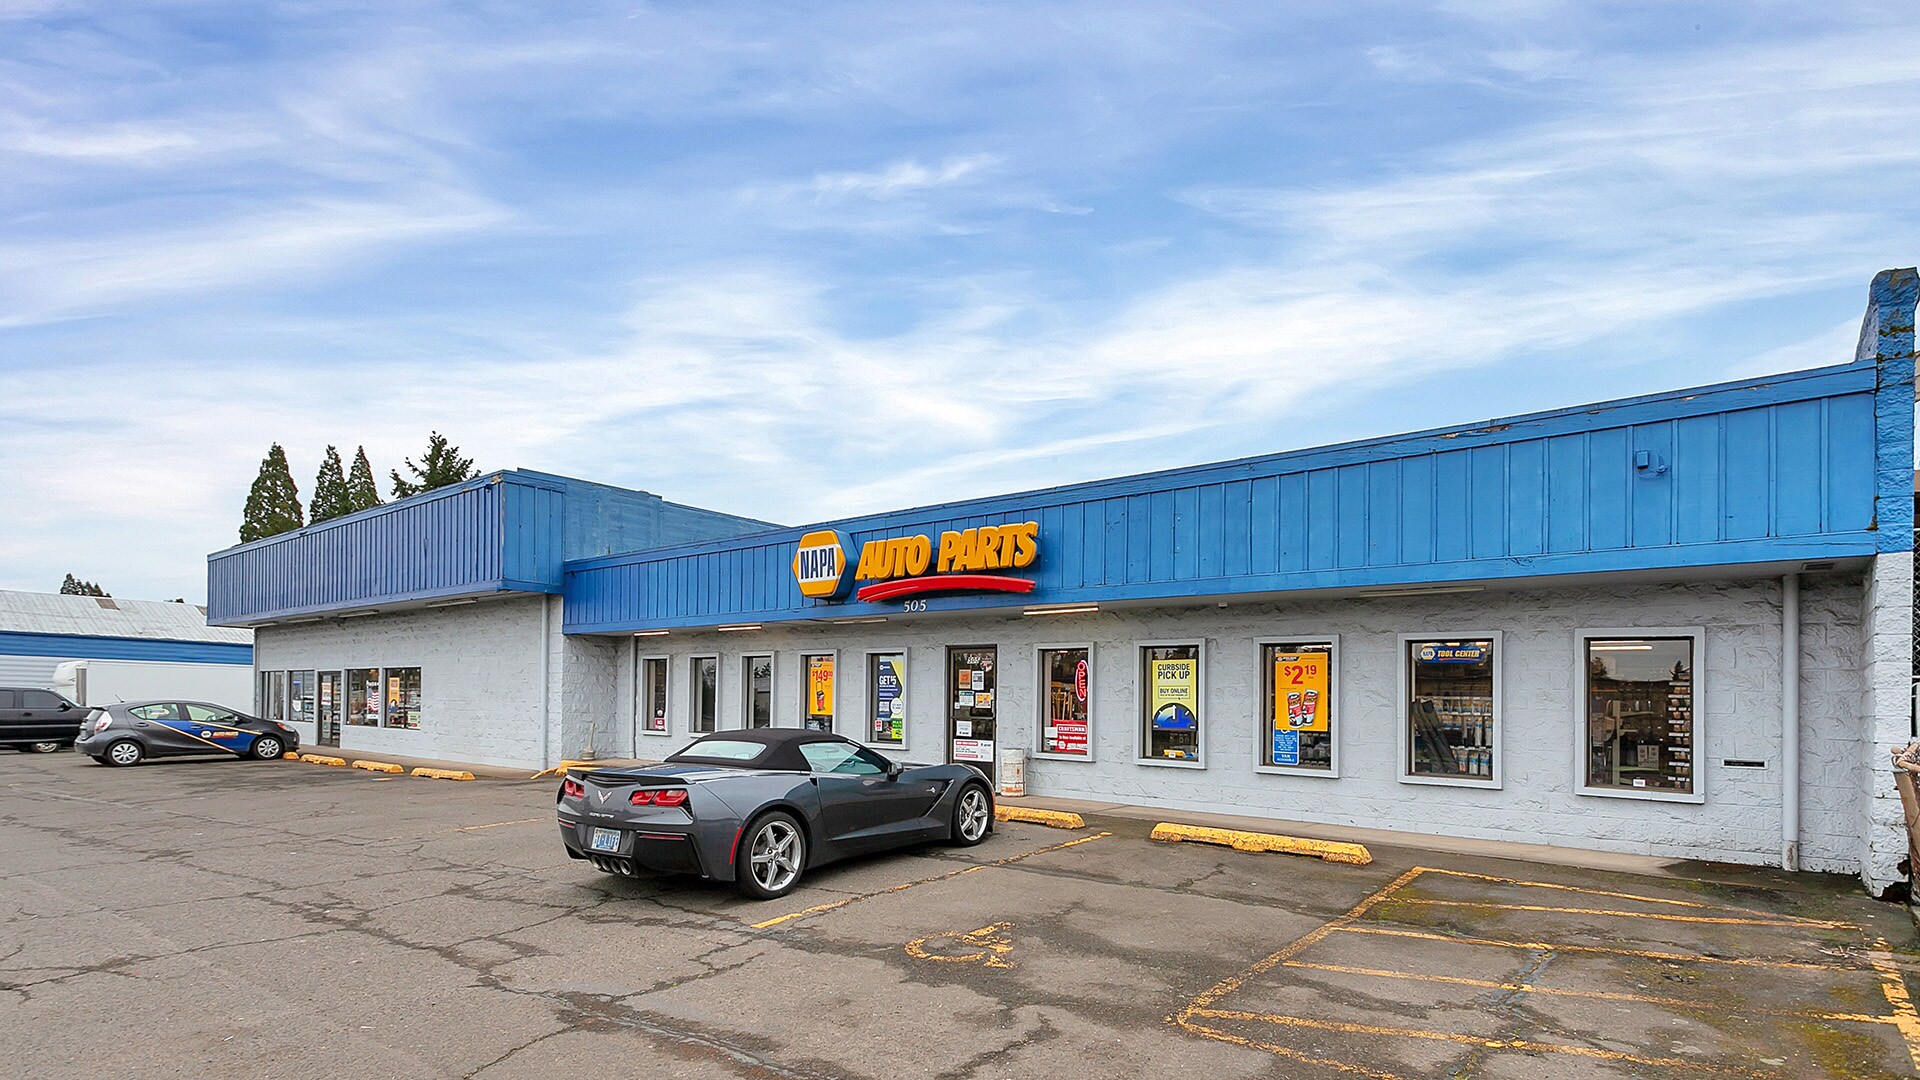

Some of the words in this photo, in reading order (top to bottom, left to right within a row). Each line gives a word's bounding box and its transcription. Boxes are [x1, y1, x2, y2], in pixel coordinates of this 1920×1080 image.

[855, 534, 932, 581] AUTO
[937, 521, 1039, 573] PARTS
[800, 547, 836, 580] NAPA
[903, 600, 927, 613] 505
[1437, 650, 1453, 658] TOOL
[1455, 650, 1480, 658] CENTER
[1157, 663, 1190, 671] CURBSIDE
[879, 675, 890, 685] GET
[1077, 662, 1086, 698] OPEN
[1157, 670, 1177, 680] PICK
[1179, 670, 1190, 680] UP
